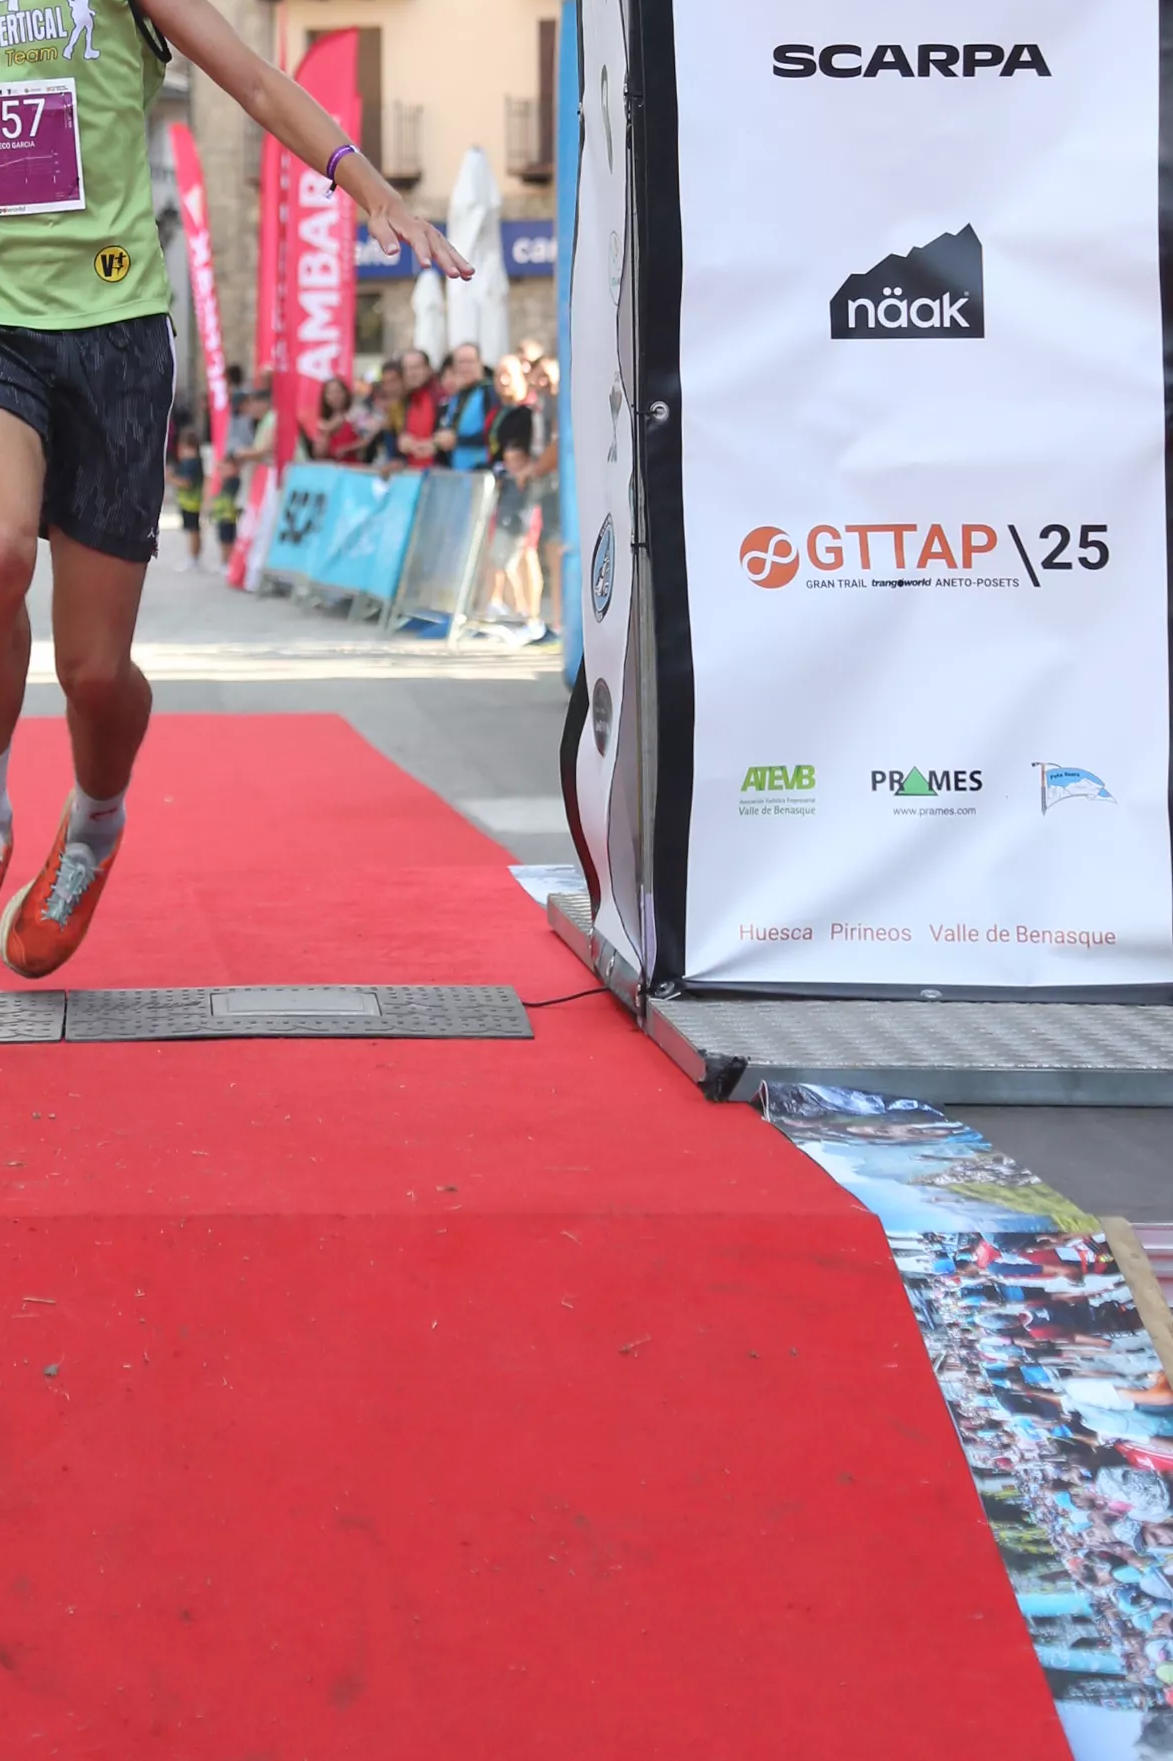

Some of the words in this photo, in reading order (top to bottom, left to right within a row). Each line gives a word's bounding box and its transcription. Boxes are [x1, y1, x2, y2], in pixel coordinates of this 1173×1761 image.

[5, 46, 58, 67] Team
[773, 43, 1052, 78] SCARPA
[296, 168, 341, 382] AMBAR
[848, 287, 970, 328] näak
[806, 524, 998, 571] GTTAP
[806, 579, 835, 589] GRAN
[838, 578, 867, 588] TRAIL
[935, 577, 1020, 588] ANETO-POSETS
[738, 805, 759, 816] Valle
[761, 805, 772, 816] de
[774, 804, 816, 818] Benasque
[893, 806, 977, 818] www.prames.com
[739, 923, 813, 942] Huesca
[830, 922, 912, 942] Pirineos
[930, 924, 979, 944] Valle
[986, 924, 1010, 944] de
[1016, 925, 1116, 948] Benasque
